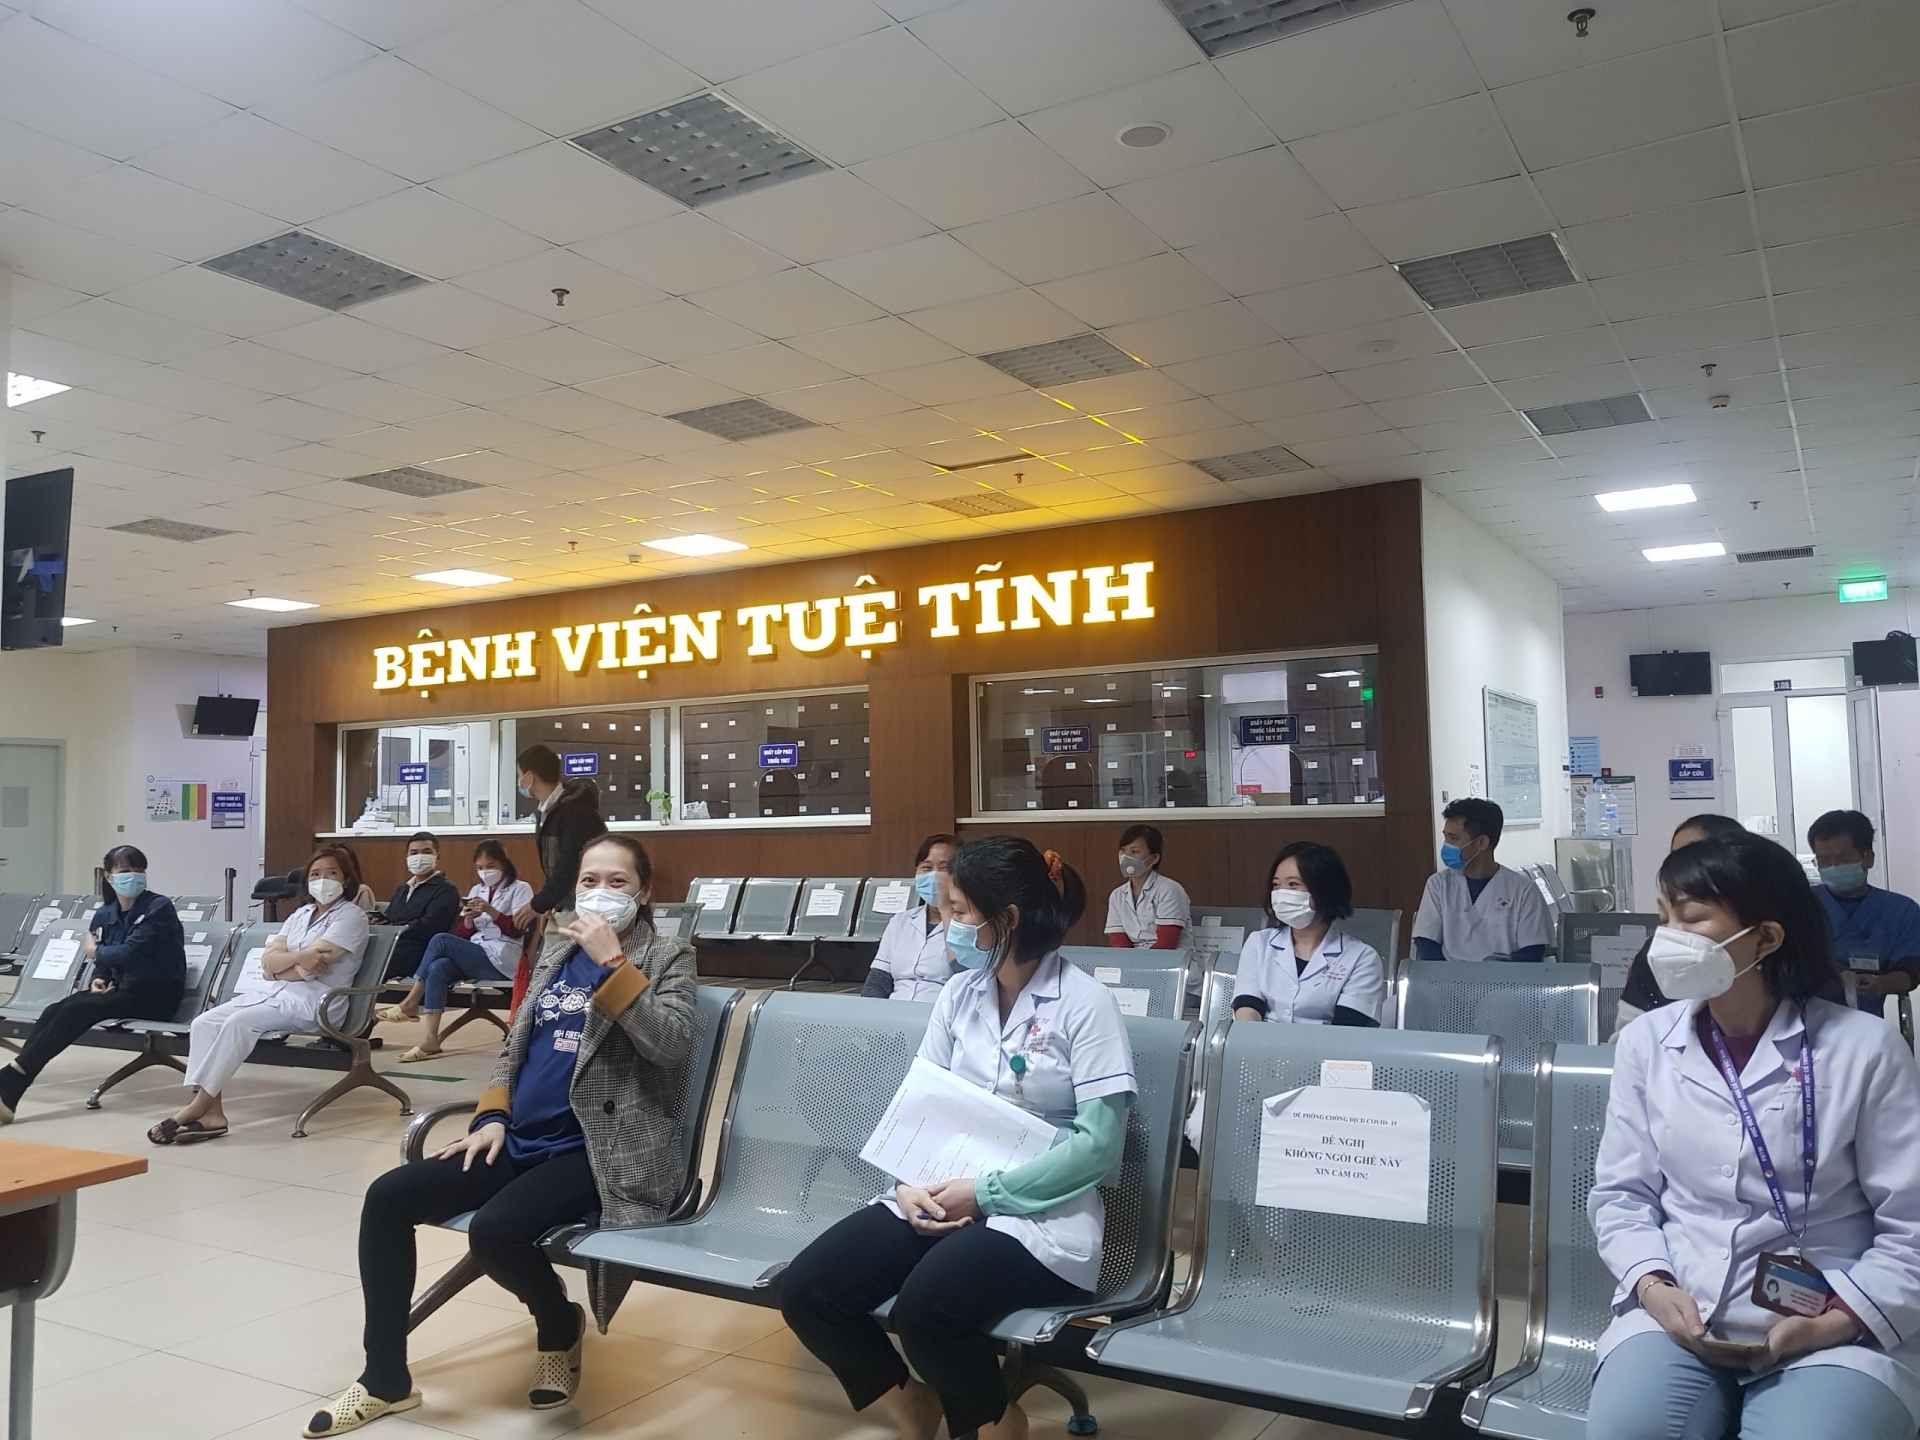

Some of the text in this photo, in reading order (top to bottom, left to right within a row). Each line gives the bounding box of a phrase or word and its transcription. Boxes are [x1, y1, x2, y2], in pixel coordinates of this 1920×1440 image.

[373, 560, 1156, 699] BỆNH VIỆN TUỆ TĨNH
[1325, 1114, 1348, 1122] CHỐNG
[1338, 1137, 1365, 1150] NGHỊ
[1285, 1148, 1402, 1168] KHÔNG NGỒI GHẾ NÀY
[1315, 1167, 1368, 1180] XIN CẢM ƠN!
